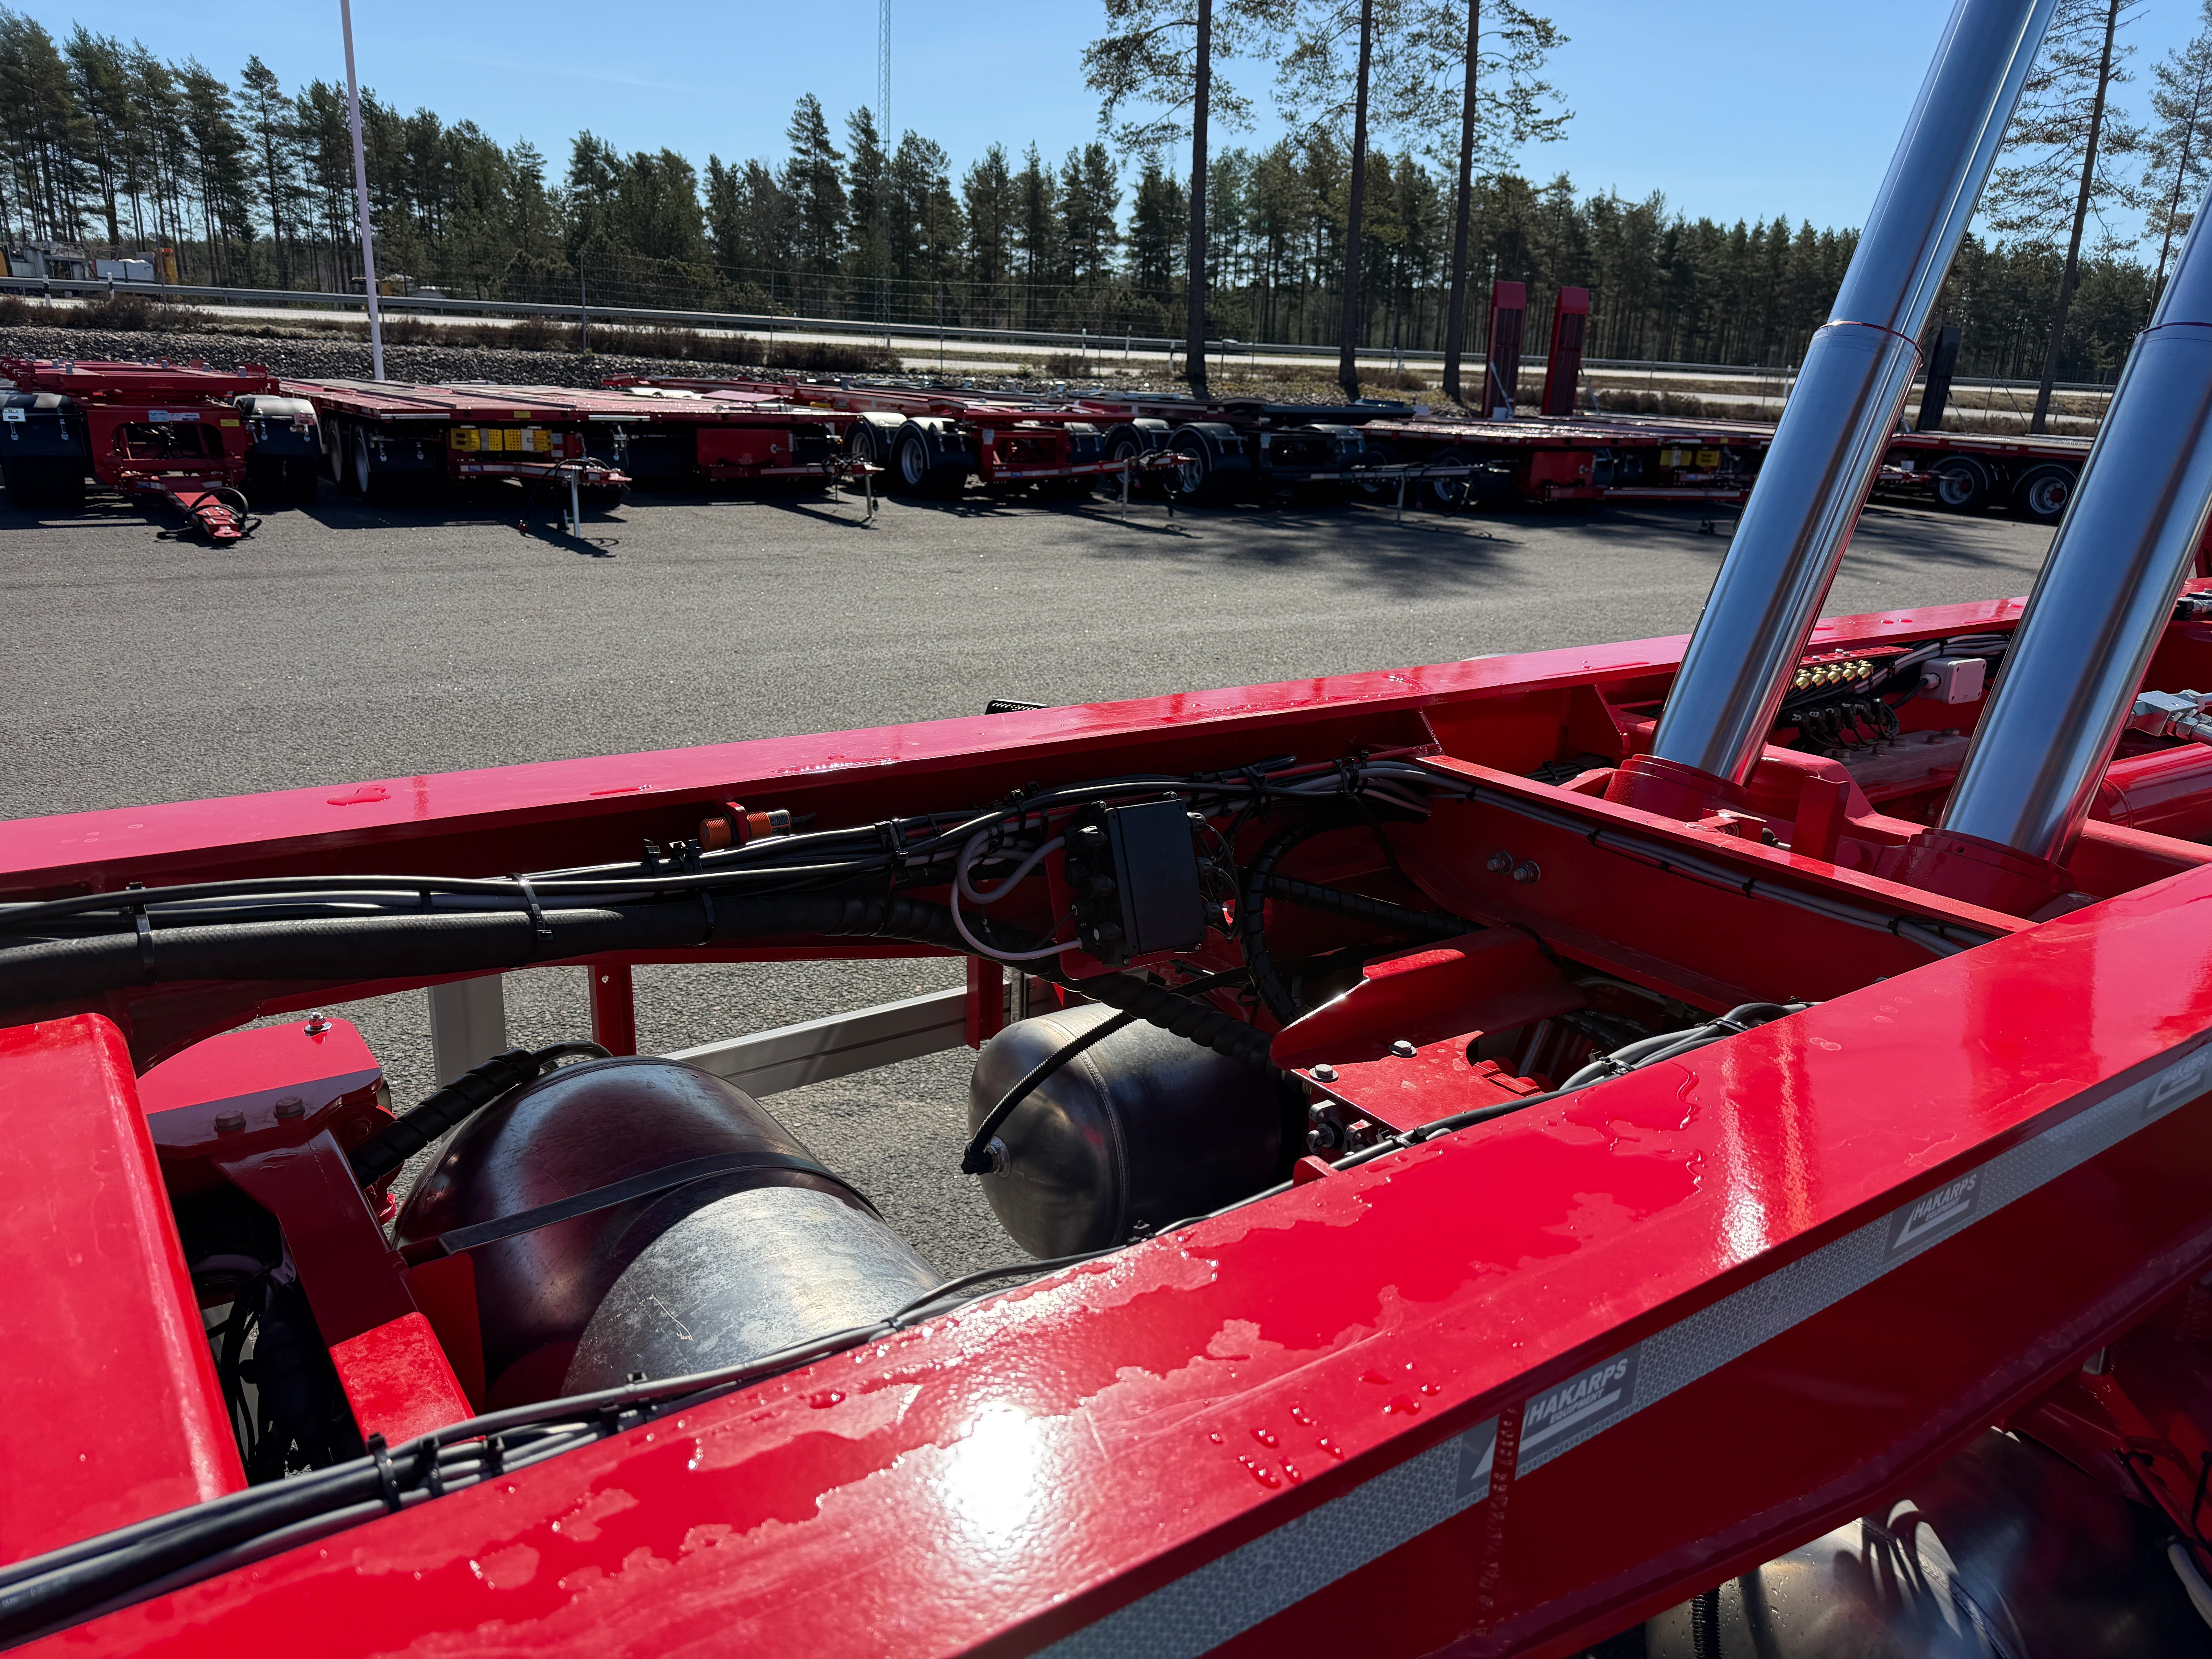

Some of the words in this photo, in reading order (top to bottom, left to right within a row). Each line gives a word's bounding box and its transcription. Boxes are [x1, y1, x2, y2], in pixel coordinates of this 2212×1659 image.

[1912, 1174, 1977, 1221] HAKARPS
[1527, 1358, 1628, 1426] HAKARPS
[1549, 1388, 1604, 1424] EQUIPMENT
